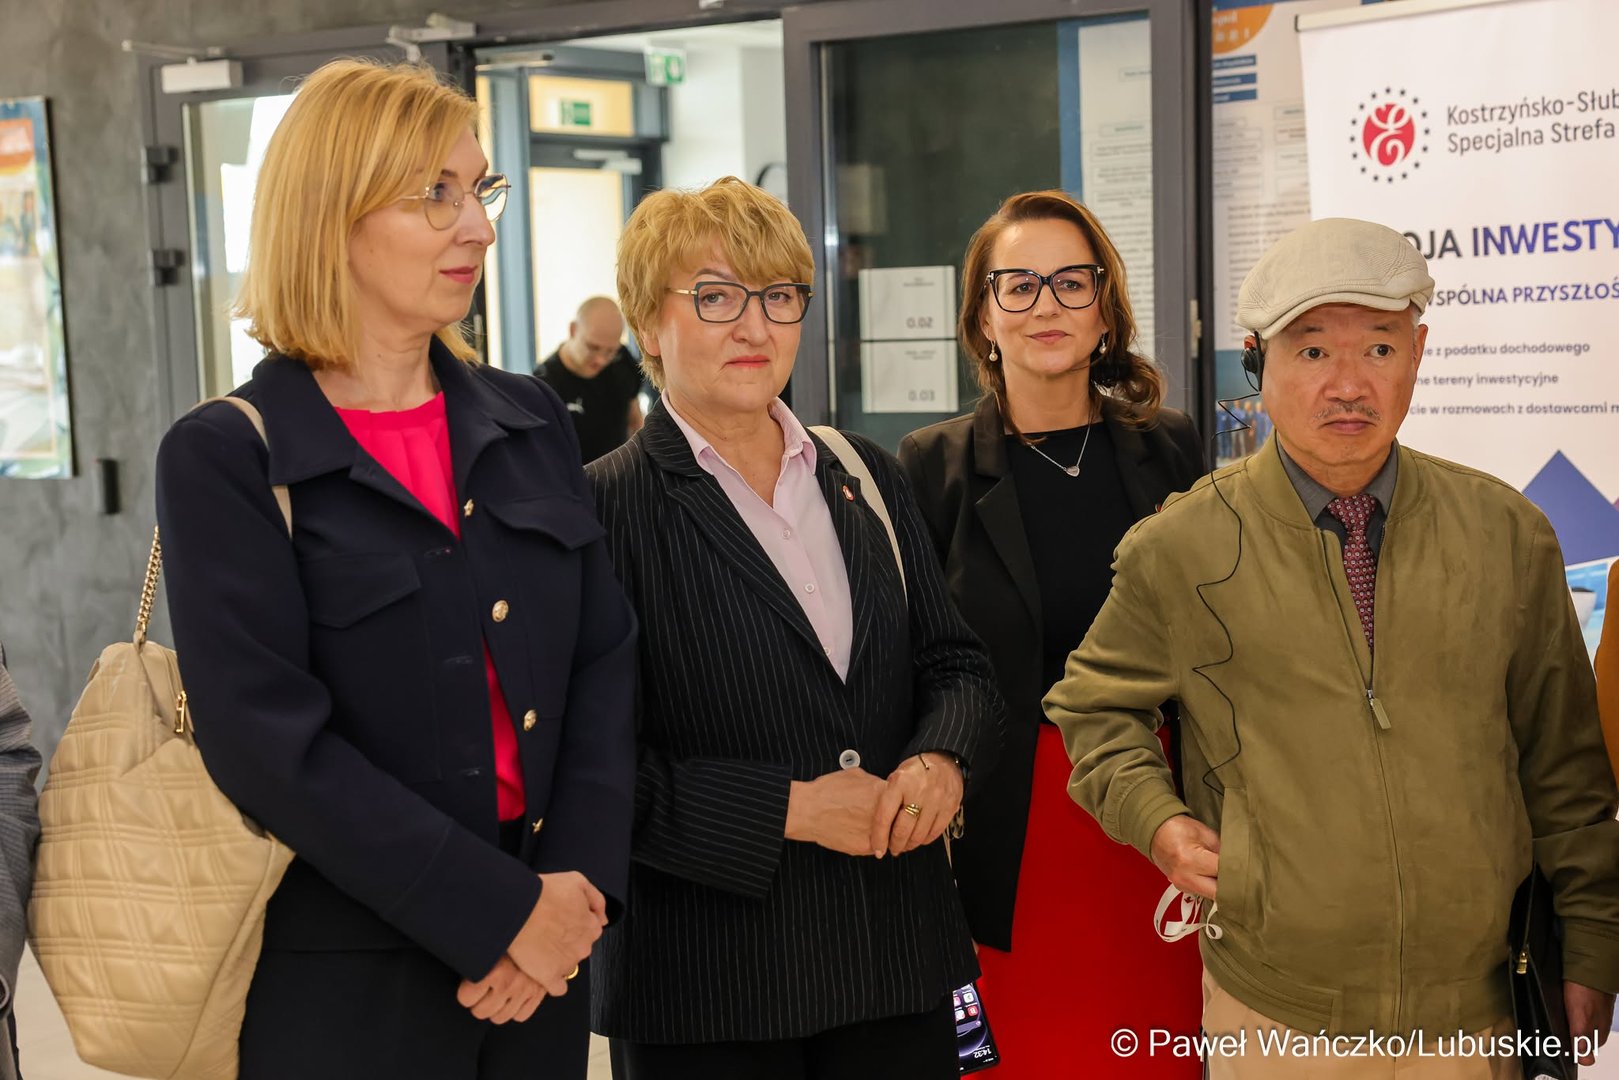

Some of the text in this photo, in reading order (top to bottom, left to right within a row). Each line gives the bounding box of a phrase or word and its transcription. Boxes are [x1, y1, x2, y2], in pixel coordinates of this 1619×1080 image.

[1447, 117, 1616, 156] Specjalna Strefa
[1444, 344, 1497, 358] podatku
[1500, 342, 1590, 356] dochodowego
[1433, 375, 1473, 387] tereny
[1476, 372, 1559, 387] inwestycyjne
[1442, 405, 1515, 415] rozmowach
[1526, 401, 1608, 415] dostawcami
